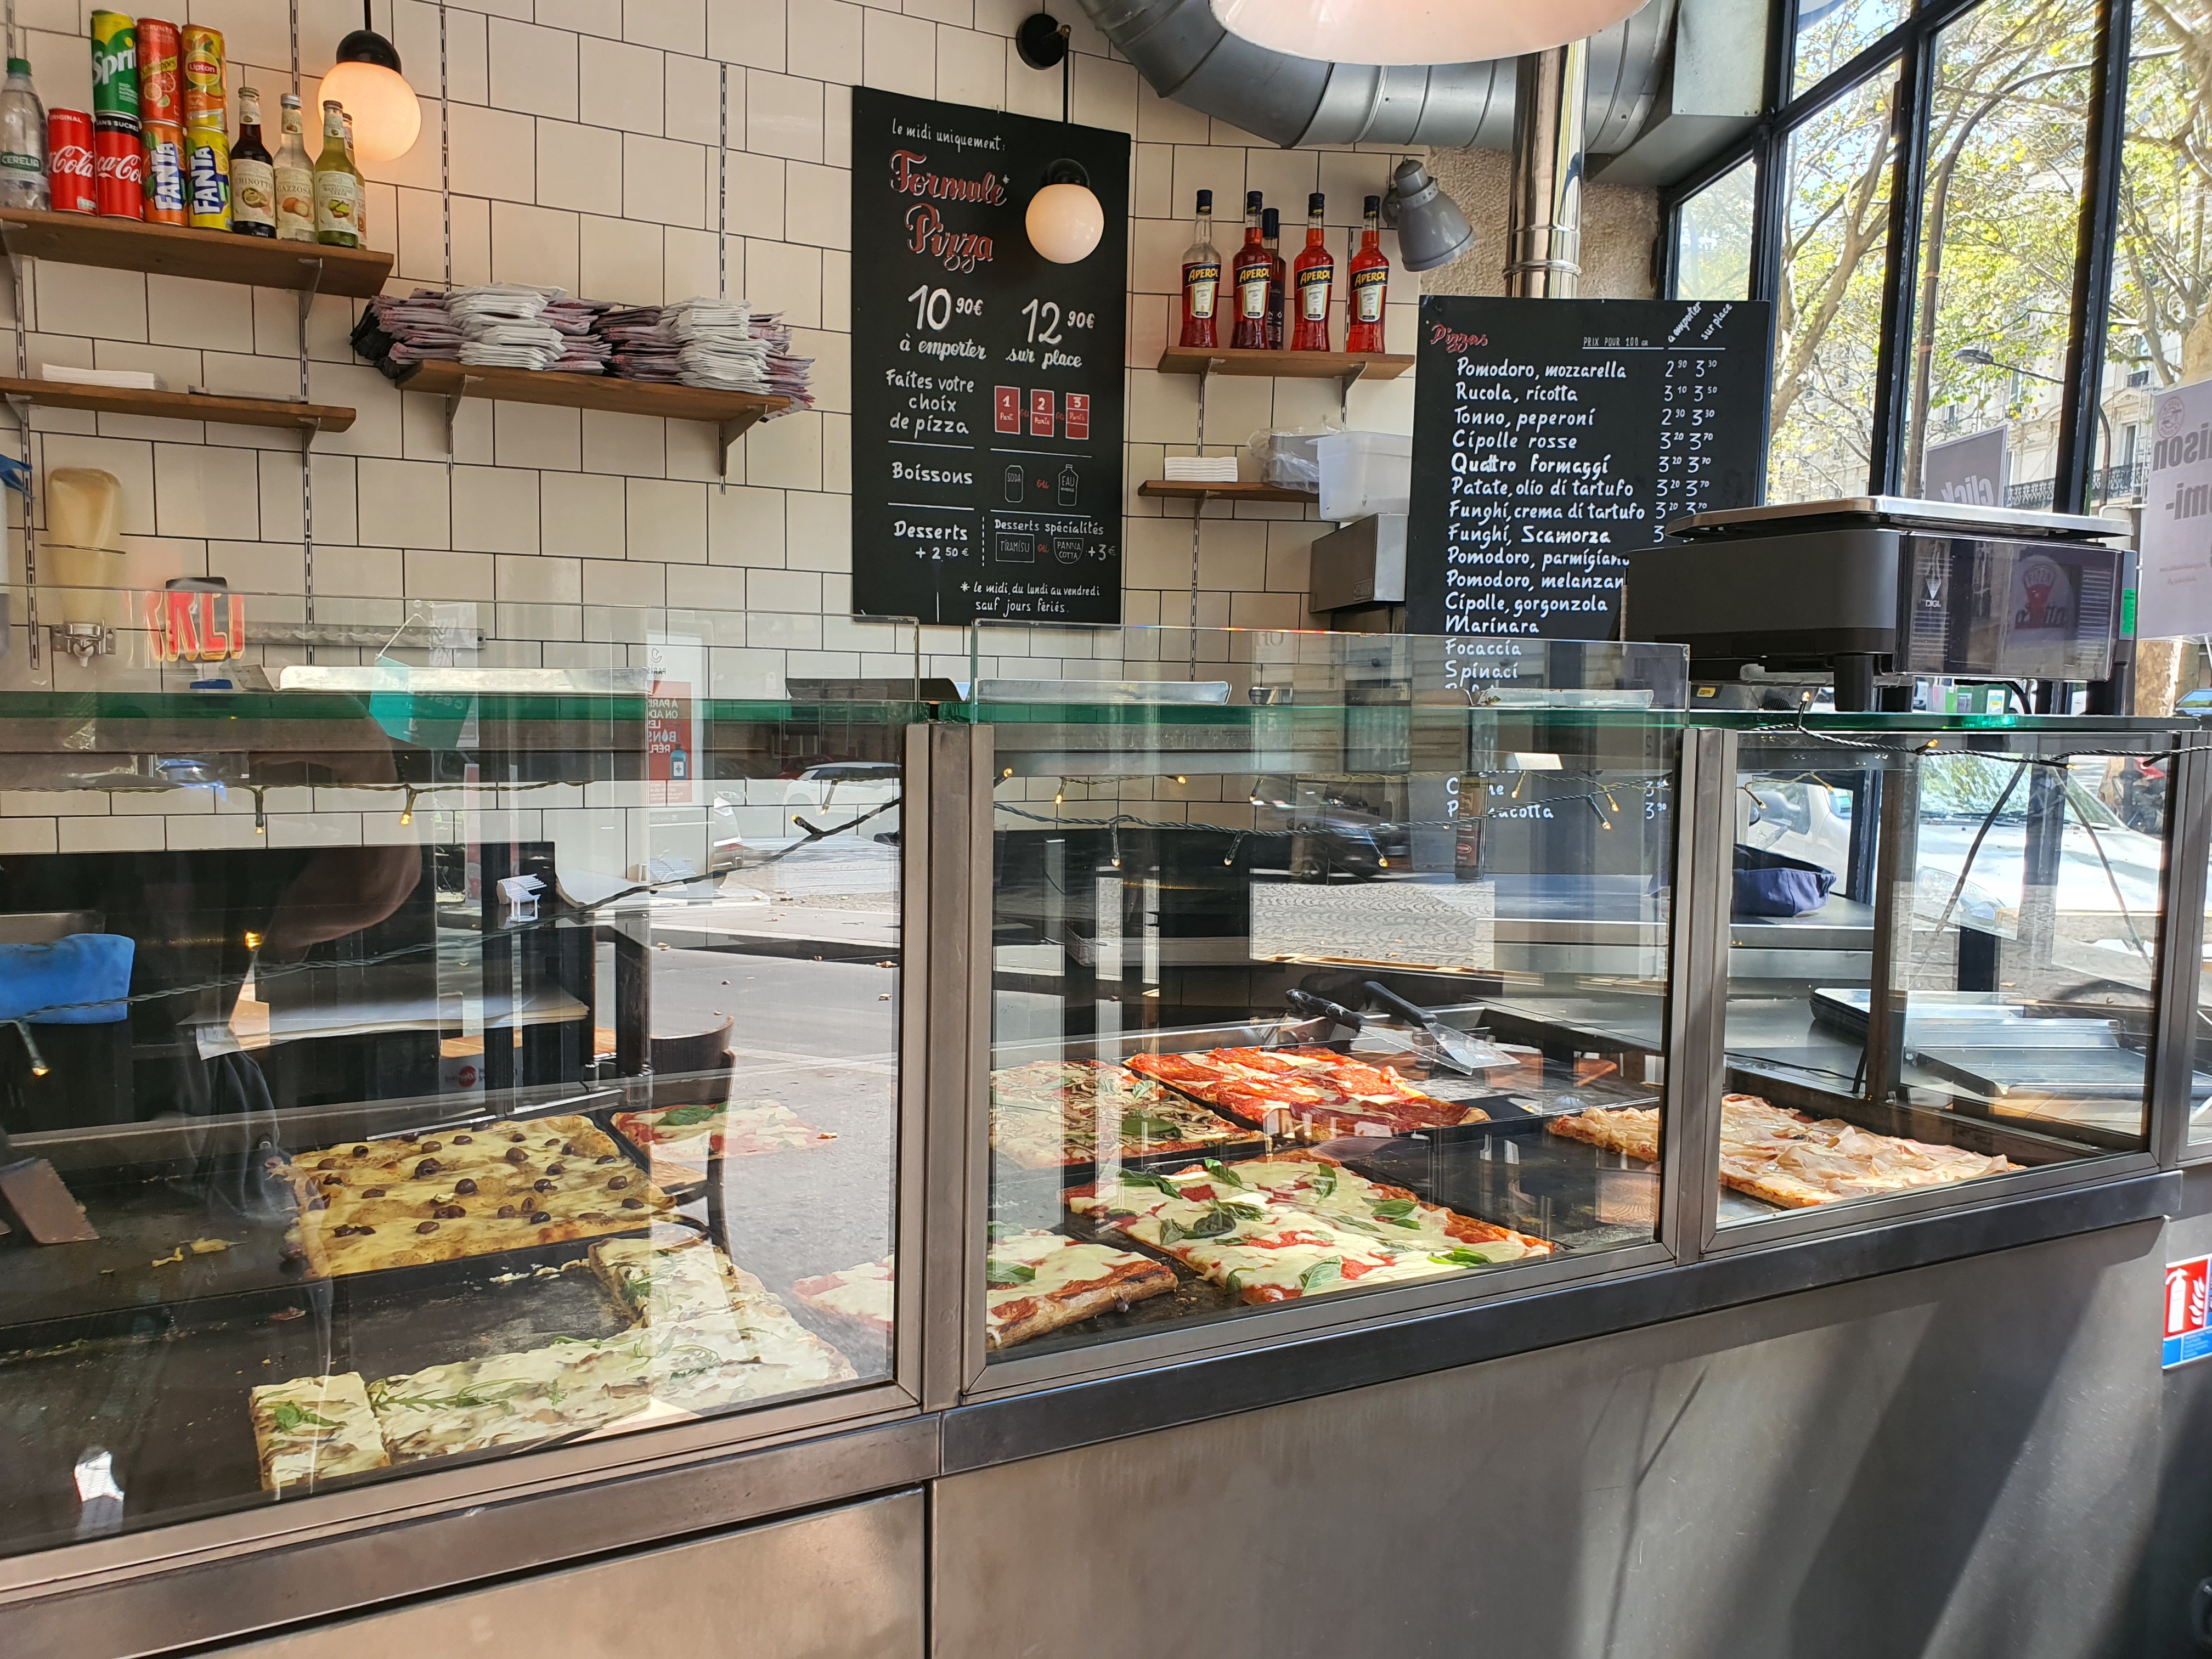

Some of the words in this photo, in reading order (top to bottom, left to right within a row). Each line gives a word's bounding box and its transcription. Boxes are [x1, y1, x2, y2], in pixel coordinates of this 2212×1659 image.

[189, 64, 216, 73] Lipton
[49, 114, 83, 124] ORIGINAL
[893, 119, 902, 134] le
[907, 123, 931, 139] midi
[151, 143, 183, 210] FANTA
[190, 147, 221, 214] FANTA
[235, 177, 273, 190] CHINOTTO
[891, 150, 1009, 206] Formule
[277, 185, 312, 195] GAZZOSA
[905, 203, 993, 273] Pizza
[1188, 268, 1218, 282] APEROL
[1239, 268, 1269, 284] APEROL
[1300, 270, 1331, 285] APEROL
[1355, 272, 1386, 288] APEROL
[908, 285, 951, 330] 10
[956, 297, 983, 315] 90€
[1673, 301, 1702, 331] emporter
[1022, 299, 1062, 344] 12
[1068, 311, 1094, 328] 90€
[1701, 324, 1715, 340] sur
[1712, 303, 1733, 329] place
[900, 333, 910, 351] à
[918, 339, 986, 361] emporter
[1430, 324, 1487, 353] Pizzas
[1583, 336, 1599, 347] PRIX
[1604, 336, 1621, 347] POUR
[1625, 336, 1638, 347] 100
[1006, 348, 1035, 363] sur
[1042, 349, 1082, 369] place
[1457, 357, 1539, 380] Pomodoro,
[1545, 361, 1626, 377] mozzarella
[886, 369, 932, 389] Faites
[938, 376, 974, 392] votre
[909, 393, 956, 412] choix
[1002, 396, 1010, 407] 1
[1074, 397, 1081, 408] 3
[1456, 382, 1519, 403] Rucola,
[1527, 385, 1578, 401] ricotta
[1037, 398, 1045, 410] 2
[890, 413, 909, 429] de
[915, 415, 969, 439] pizza
[1454, 405, 1511, 428] Tonno,
[1516, 408, 1595, 433] peperoni
[1453, 429, 1517, 454] Cipolle
[1528, 437, 1577, 449] rosse
[892, 462, 972, 484] Boissons
[1007, 473, 1020, 482] SODA
[1452, 453, 1516, 475] Quattro
[1531, 454, 1611, 481] formaggi
[1062, 476, 1075, 487] EAU
[1452, 476, 1513, 498] Patate,
[1516, 479, 1543, 495] olio
[1550, 478, 1567, 495] di
[1572, 479, 1633, 496] tartufo
[1449, 499, 1511, 526] Funghi,
[1514, 507, 1562, 518] crema
[1568, 502, 1584, 518] di
[1587, 503, 1645, 520] tartufo
[894, 521, 967, 540] Desserts
[995, 519, 1039, 531] Desserts
[1045, 521, 1103, 535] spécialités
[1448, 523, 1511, 550] Funghi,
[1521, 526, 1611, 544] Scamorza
[1057, 541, 1081, 551] PANNA
[1059, 551, 1077, 560] COTTA
[1448, 546, 1535, 569] Pomodoro,
[974, 582, 981, 592] le
[1012, 583, 1023, 593] du
[1028, 583, 1048, 594] lundi
[1064, 585, 1099, 595] vendredi
[1447, 569, 1534, 591] Pomodoro,
[1542, 572, 1625, 589] melanzan
[976, 597, 1000, 611] sauf
[1003, 600, 1031, 617] jours
[1446, 591, 1509, 614] Cipolle,
[1513, 594, 1607, 618] gorgonzola
[1446, 614, 1539, 633] Marinara
[1444, 639, 1522, 657] Focaccia
[1444, 659, 1519, 687] Spinaci
